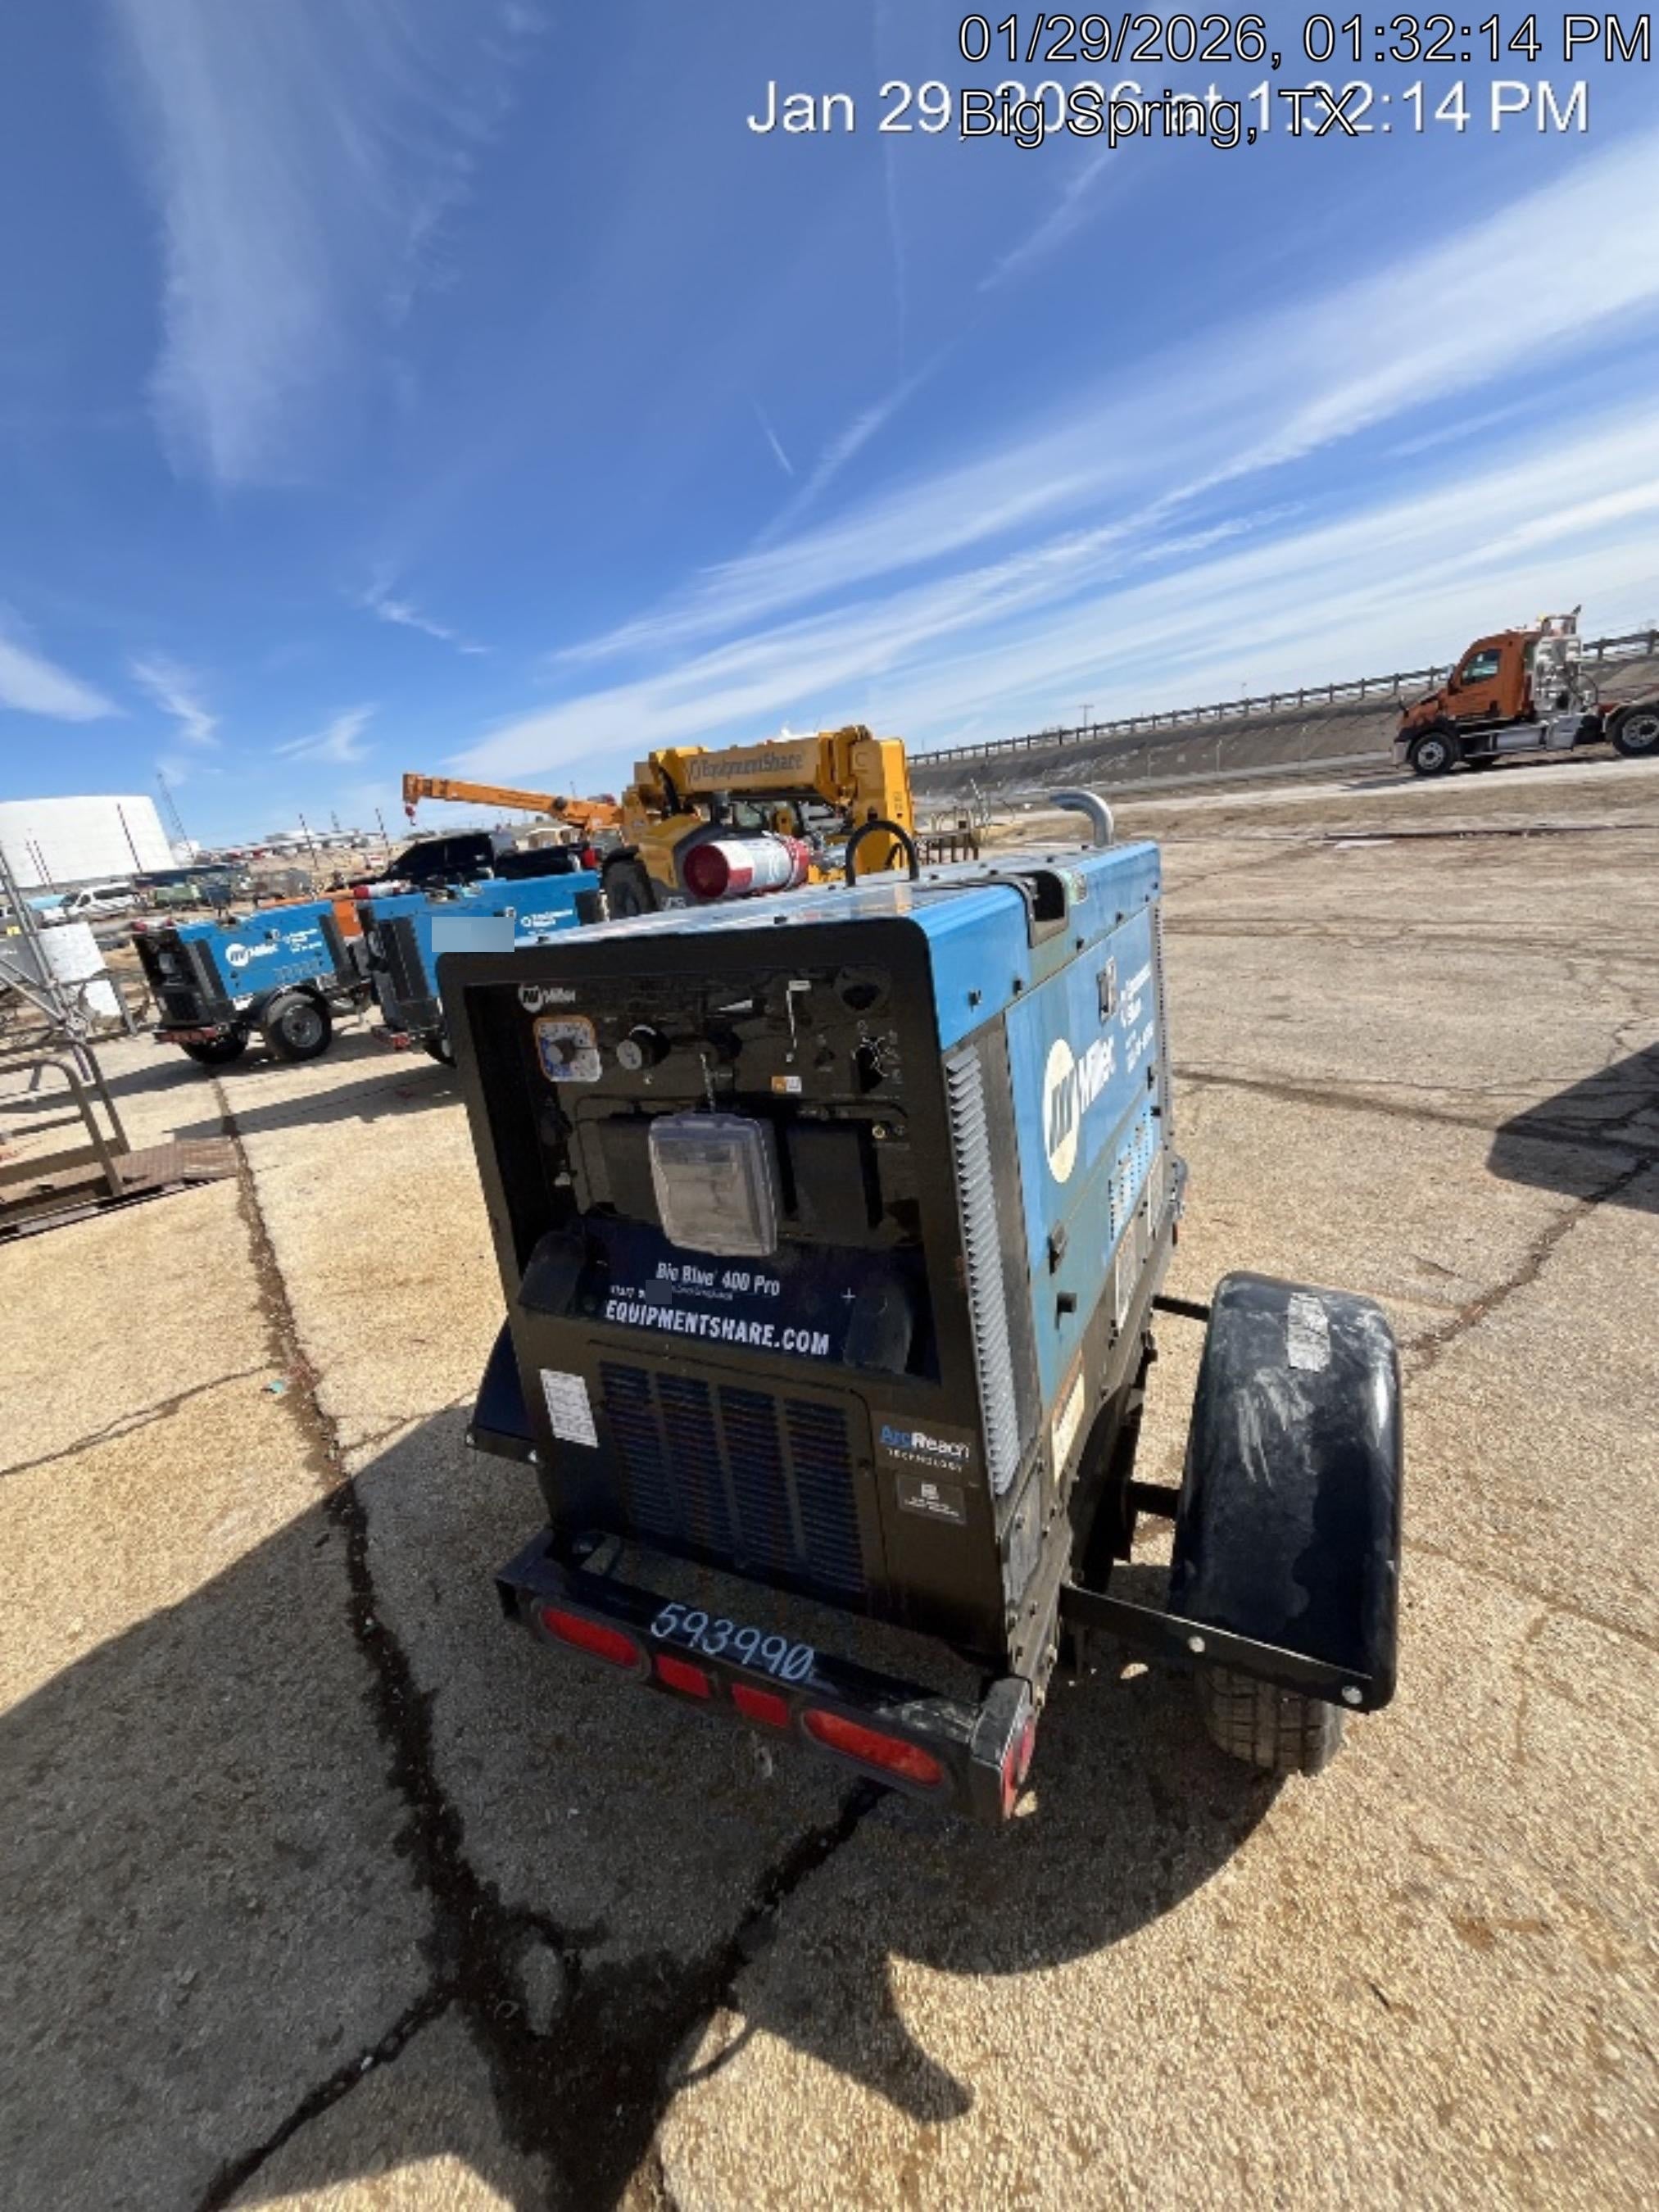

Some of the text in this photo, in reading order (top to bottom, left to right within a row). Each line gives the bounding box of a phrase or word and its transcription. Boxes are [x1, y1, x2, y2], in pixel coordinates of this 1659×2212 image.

[655, 1262, 679, 1282] Big
[722, 1270, 750, 1292] 400
[754, 1275, 780, 1297] Pro
[605, 1299, 830, 1355] EQUIPMENTSHARE.COM
[880, 1425, 970, 1460] ArcReach
[650, 1602, 814, 1679] 593990
